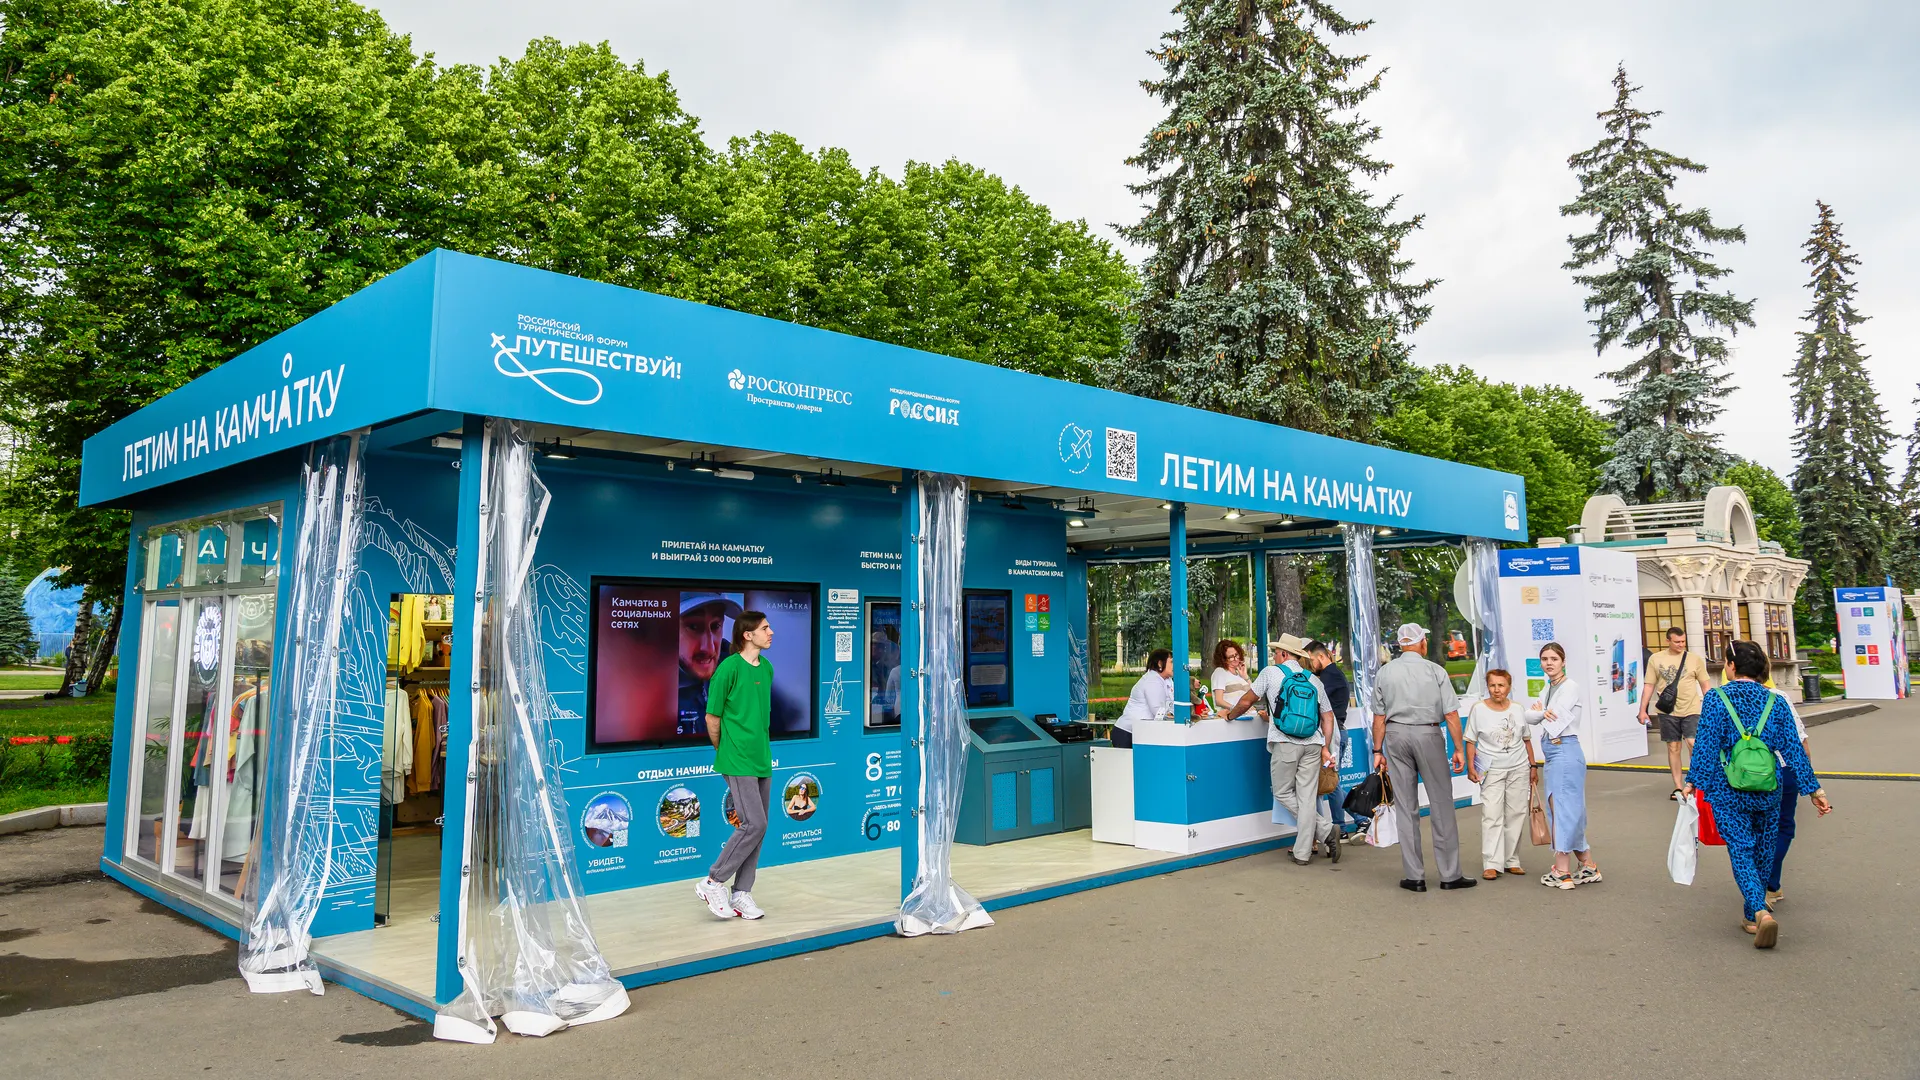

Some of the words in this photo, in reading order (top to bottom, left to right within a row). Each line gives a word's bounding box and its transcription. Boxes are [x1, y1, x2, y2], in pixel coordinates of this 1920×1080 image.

[518, 314, 580, 332] РОССИЙСКИЙ
[518, 322, 594, 342] ТУРИСТИЧЕСКИЙ
[597, 337, 628, 348] ФОРУМ
[515, 335, 682, 379] ПУТЕШЕСТВУЙ!
[748, 375, 852, 405] РОСКОНГРЕСС
[747, 394, 795, 410] Пространство
[796, 403, 822, 414] доверия
[122, 426, 178, 481] ЛЕТИМ
[184, 416, 210, 461] НА
[214, 353, 345, 450] КАМЧАТКУ
[888, 398, 959, 426] РОССИЯ
[1160, 453, 1256, 498] ЛЕТИМ
[1263, 468, 1298, 503] НА
[1304, 466, 1412, 518] КАМЧАТКУ
[662, 540, 706, 550] ПРИЛЕТАЙ
[708, 543, 721, 551] НА
[722, 544, 765, 553] КАМЧАТКУ
[652, 552, 658, 560] И
[660, 552, 701, 562] ВЫИГРАЙ
[703, 554, 708, 562] 3
[710, 555, 724, 563] 000
[726, 556, 741, 564] 000
[742, 556, 773, 565] РУБЛЕЙ
[861, 562, 889, 570] БЫСТРО
[612, 597, 659, 607] Камчатка
[766, 599, 808, 610] КАМЧАТКА
[611, 610, 671, 619] социальных
[638, 768, 673, 780] ОТДЫХ
[886, 786, 897, 797] 17
[866, 812, 881, 841] 6
[782, 828, 822, 840] ИСКУПАТЬСЯ
[659, 846, 697, 857] ПОСЕТИТЬ
[588, 856, 624, 867] УВИДЕТЬ
